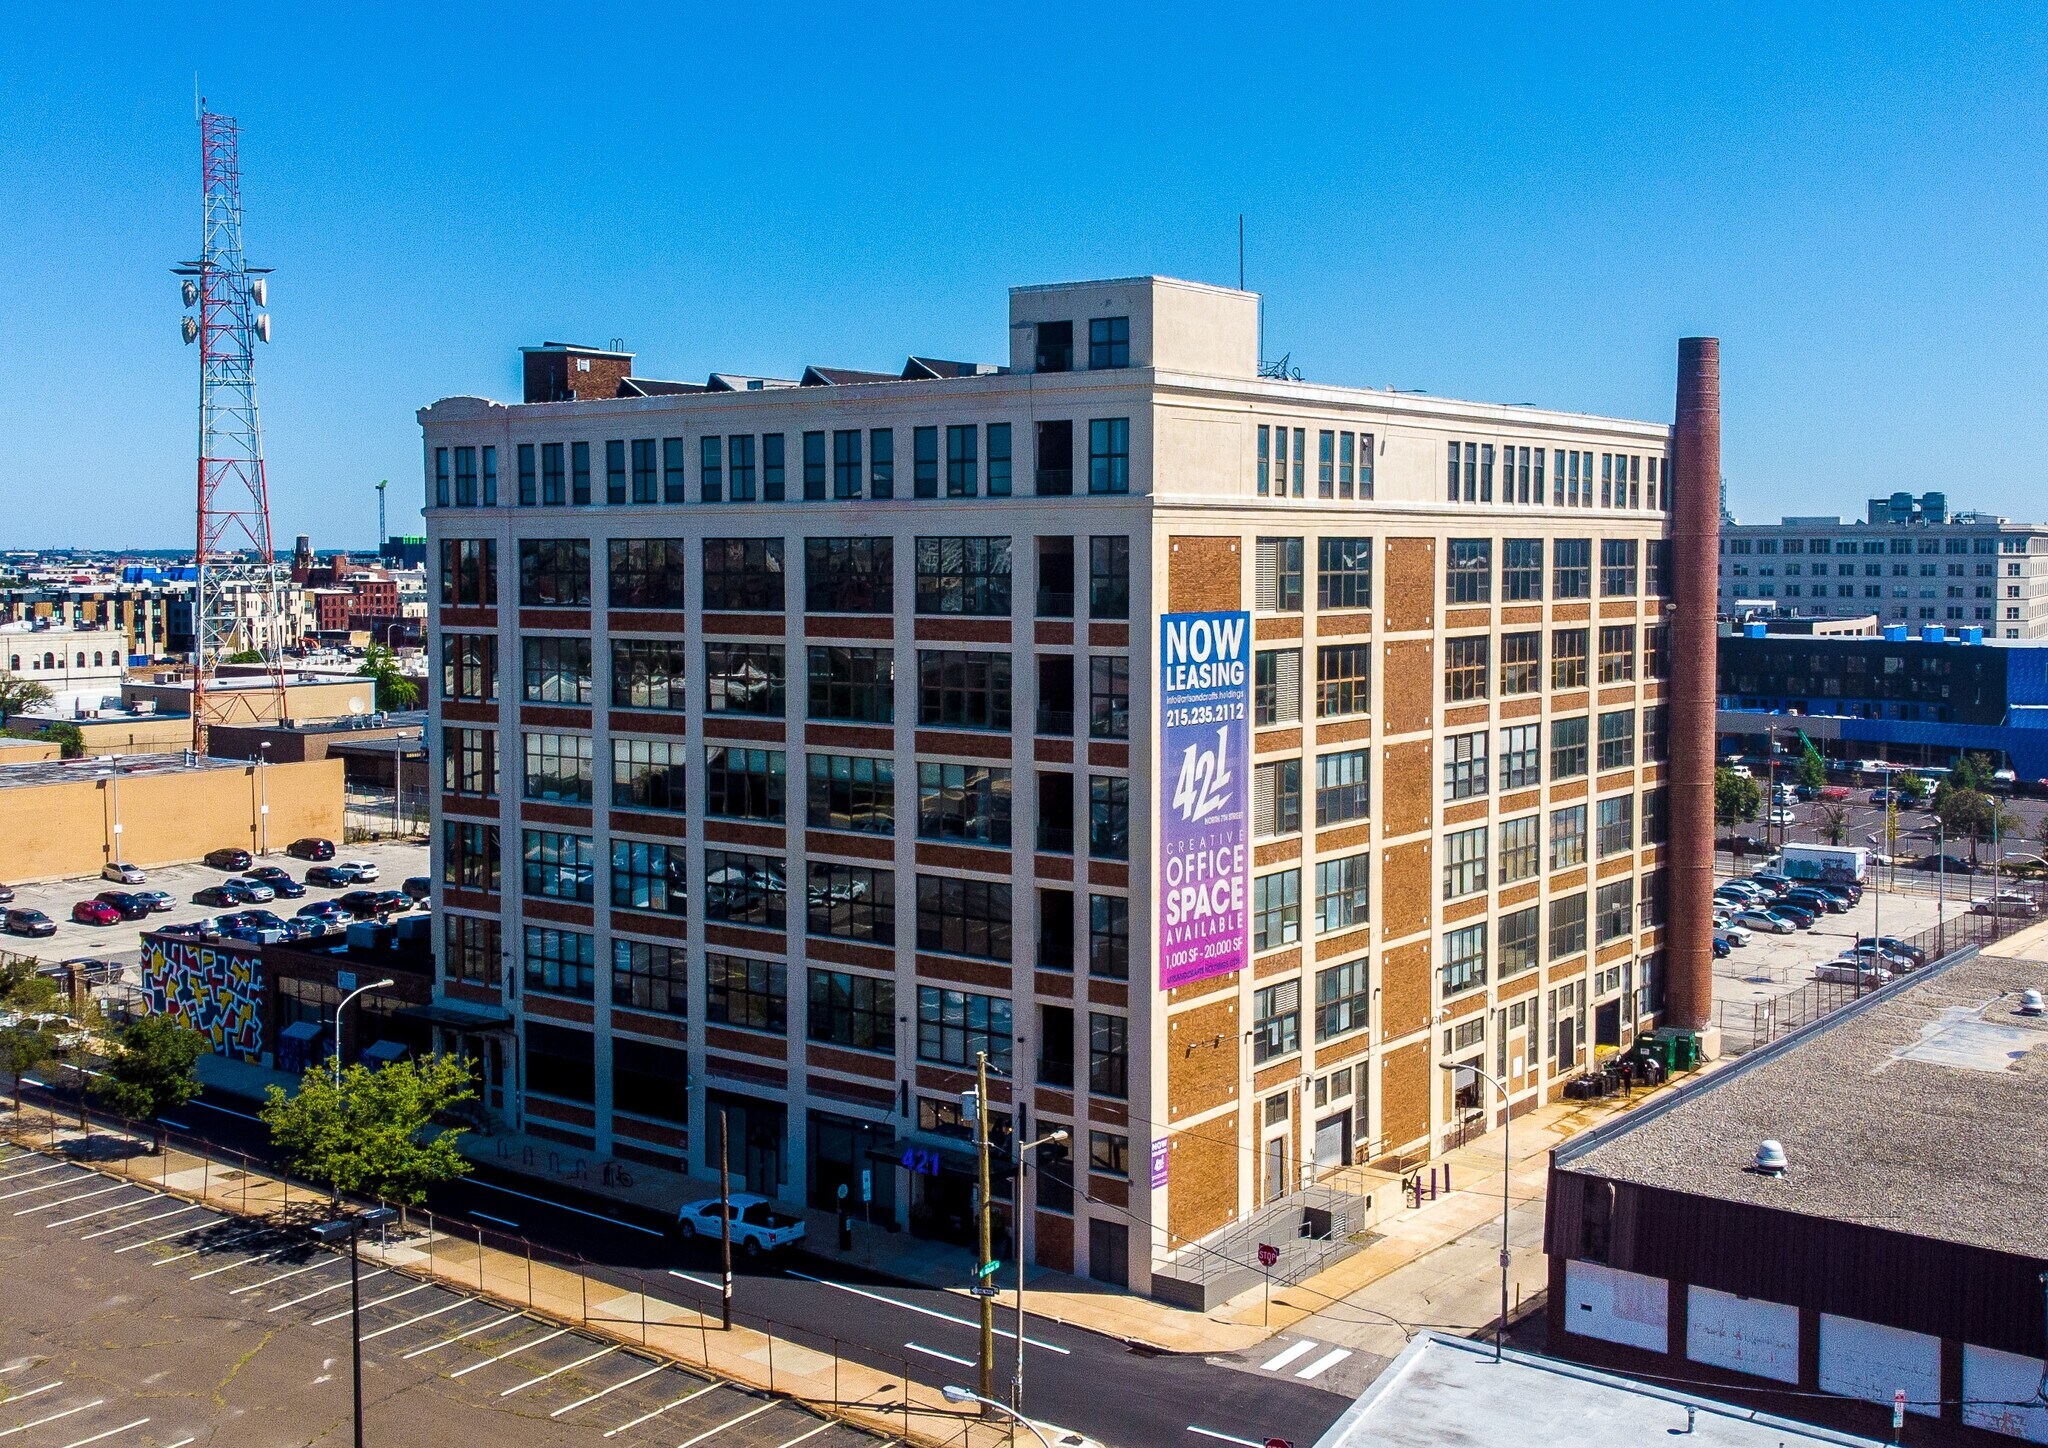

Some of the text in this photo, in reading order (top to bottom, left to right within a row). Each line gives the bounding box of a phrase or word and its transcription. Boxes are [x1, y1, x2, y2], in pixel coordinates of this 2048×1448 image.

[1167, 619, 1245, 665] NOW
[1167, 661, 1244, 692] LEASING
[1167, 703, 1244, 727] 215.235.2112
[1172, 725, 1233, 823] 421
[1167, 830, 1244, 855] CREATIVE
[1166, 844, 1244, 887] OFFICE
[1166, 876, 1244, 926] SPACE
[1166, 912, 1243, 947] AVAILABLE
[1166, 950, 1187, 970] 1,000
[1189, 947, 1198, 963] SF
[1204, 939, 1231, 958] 20,000
[1233, 937, 1243, 951] SF
[1152, 1138, 1167, 1151] NOW
[902, 1147, 939, 1176] 421
[1259, 1251, 1276, 1261] STOP
